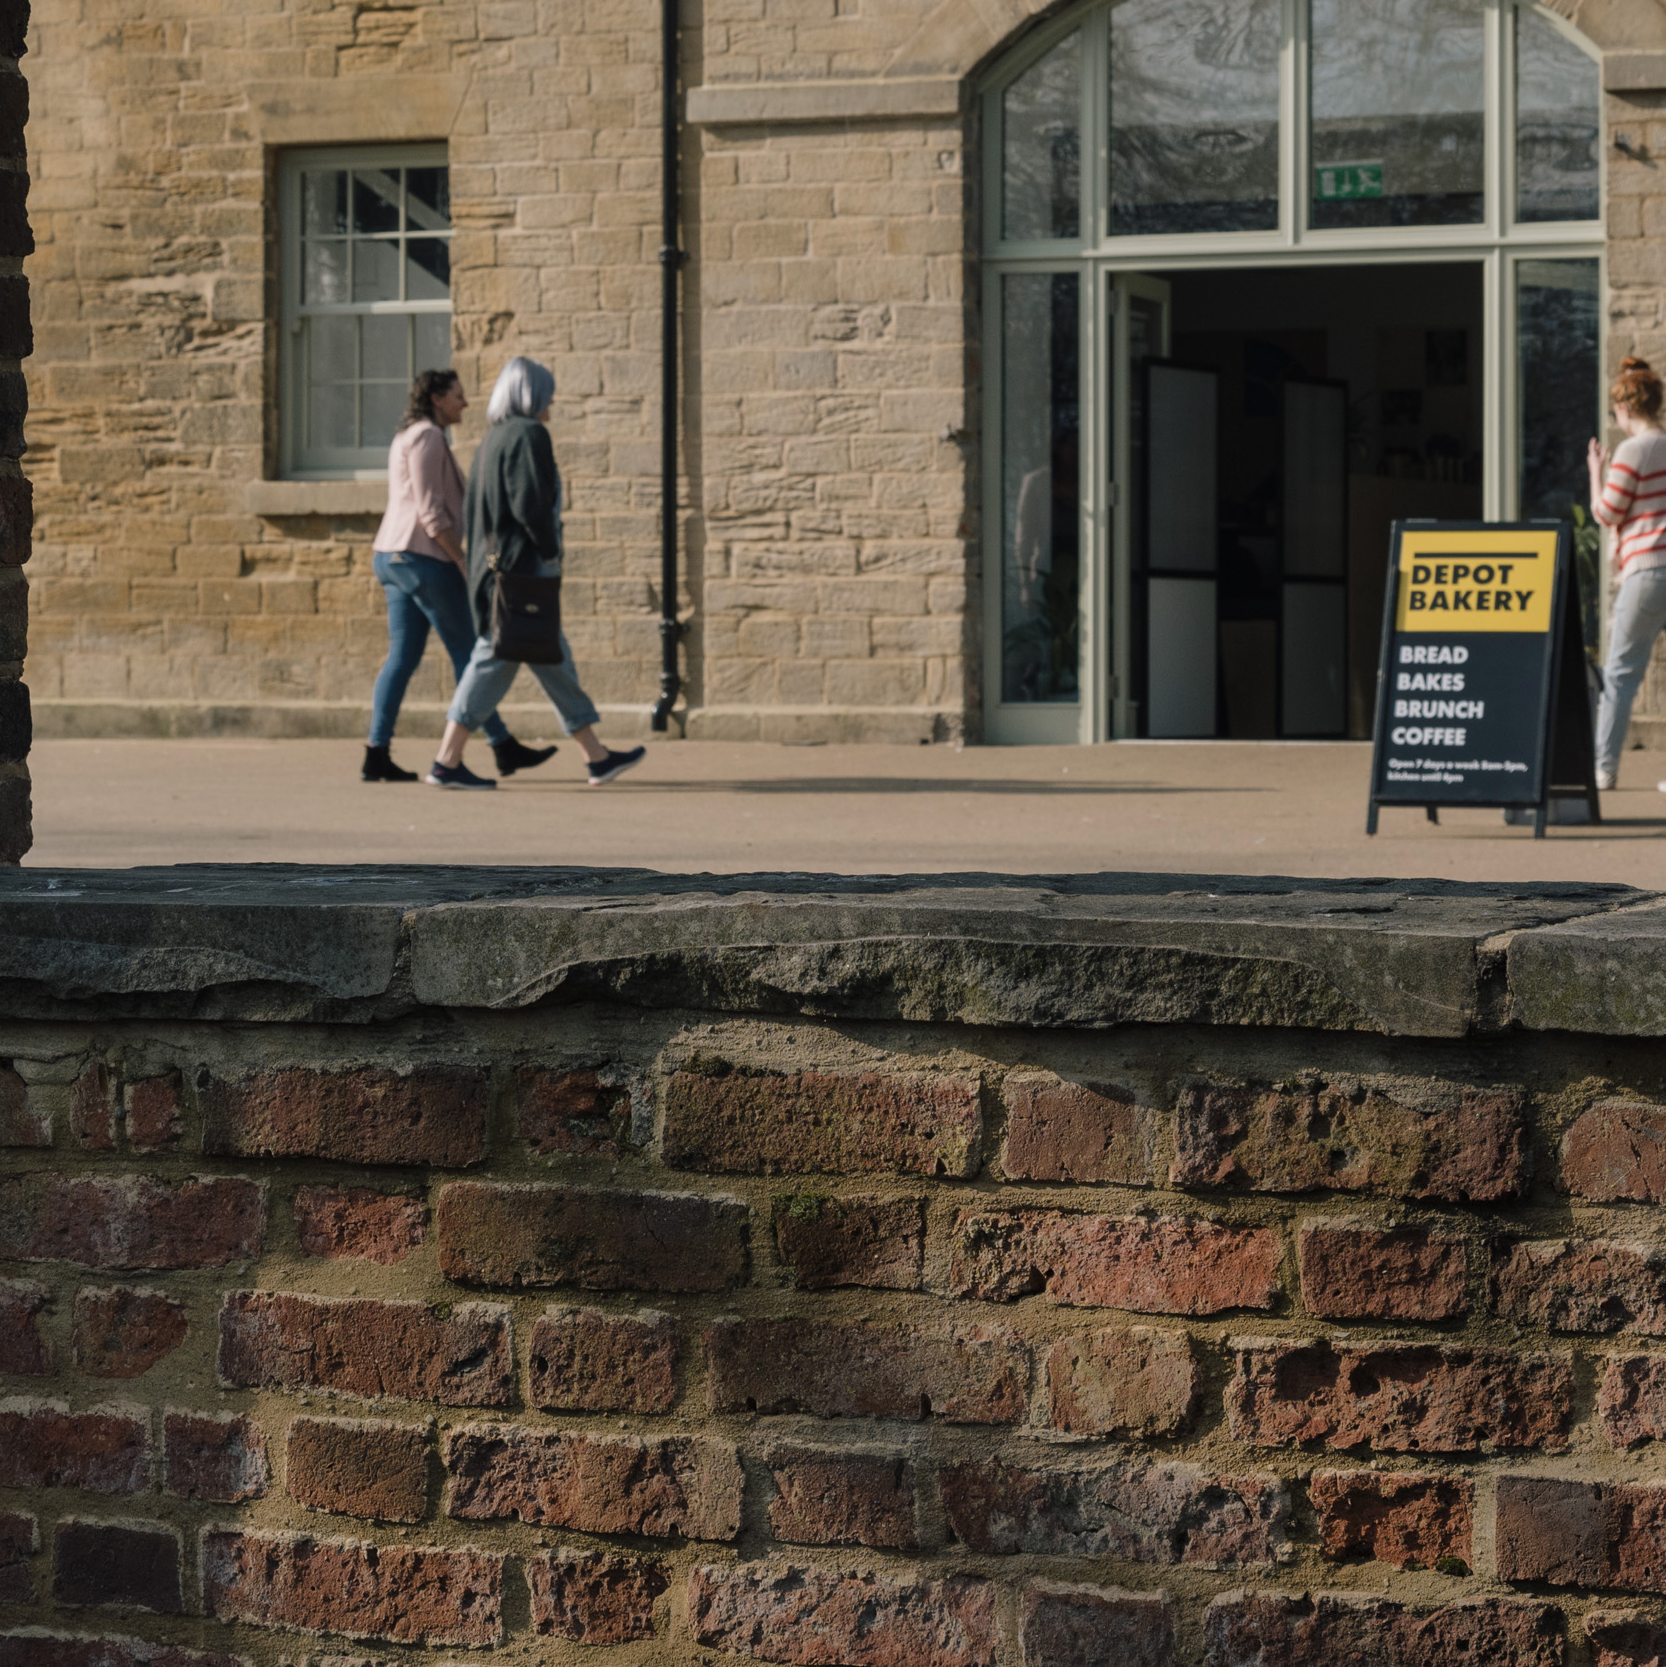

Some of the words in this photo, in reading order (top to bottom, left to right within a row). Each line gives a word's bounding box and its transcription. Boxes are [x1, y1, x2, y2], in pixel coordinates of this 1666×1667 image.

[1411, 565, 1514, 585] DEPOT
[1409, 590, 1534, 611] BAKERY
[1399, 646, 1469, 664] BREAD
[1397, 673, 1465, 691] BAKES
[1394, 700, 1484, 719] BRUNCH
[1391, 727, 1466, 746] COFFEE
[1388, 758, 1414, 770] Open
[1415, 758, 1423, 769] 7
[1423, 759, 1445, 771] days
[1446, 761, 1454, 769] a
[1454, 760, 1479, 770] week
[1387, 771, 1420, 781] kitchen
[1421, 772, 1441, 782] until
